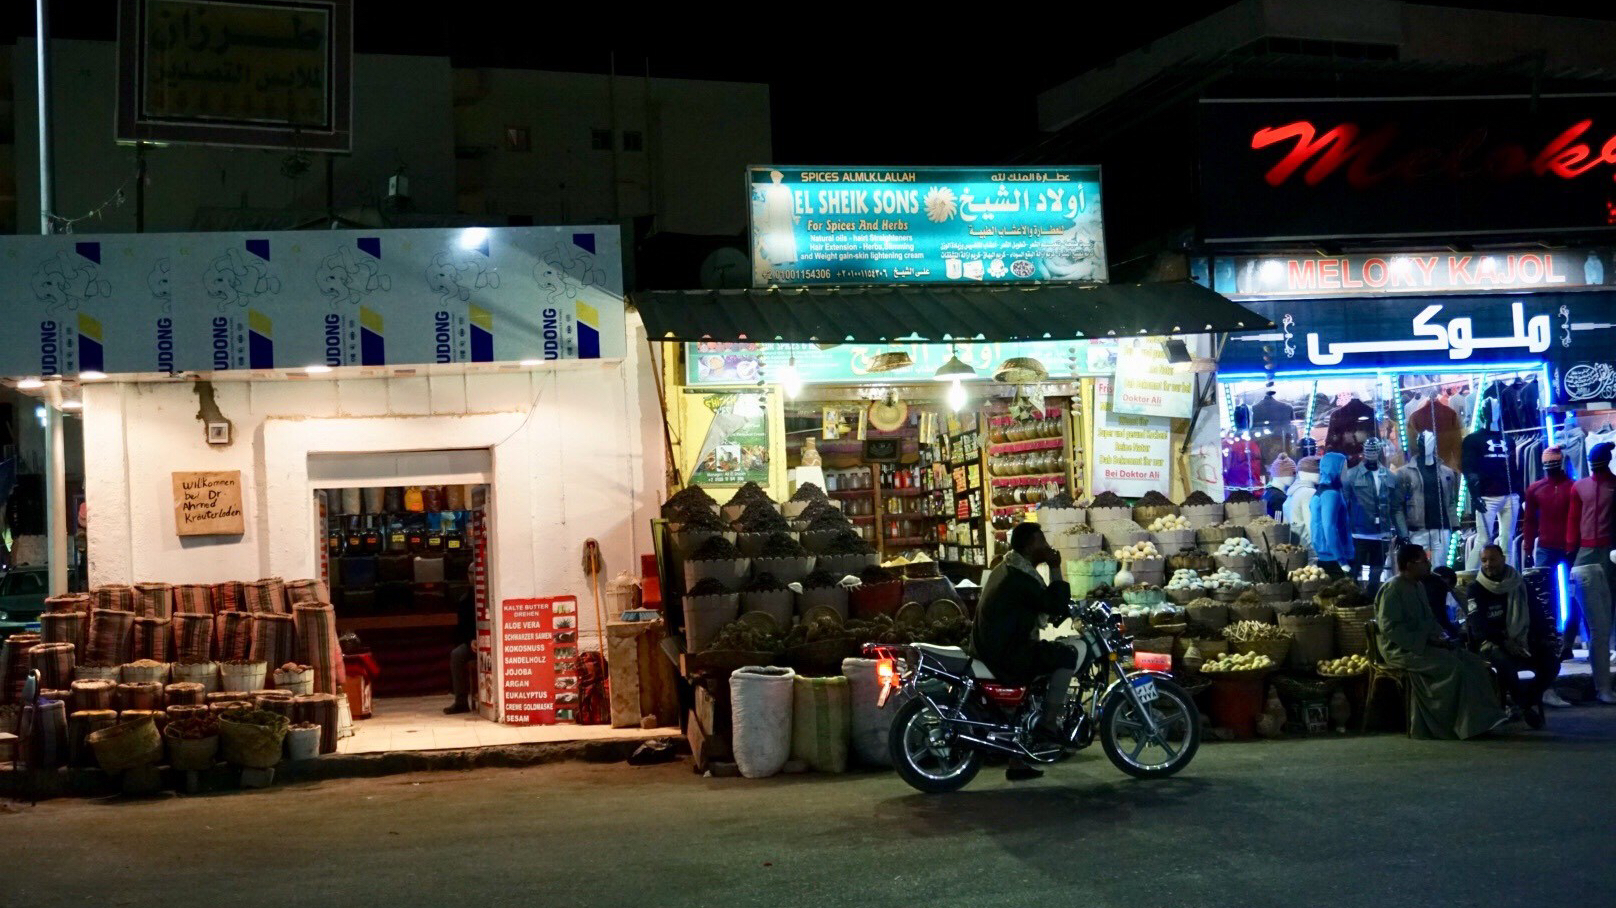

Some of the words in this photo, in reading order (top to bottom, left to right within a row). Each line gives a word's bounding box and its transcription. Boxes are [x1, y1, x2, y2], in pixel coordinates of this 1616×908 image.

[801, 172, 839, 182] SPICES
[794, 190, 814, 214] EL
[818, 190, 869, 214] SHEIK
[873, 190, 919, 214] SONS
[959, 183, 1029, 222] الشيخ
[1036, 183, 1085, 219] أولاد
[807, 220, 823, 231] For
[826, 219, 855, 233] Spices
[858, 219, 878, 231] And
[881, 219, 908, 231] Herbs
[810, 244, 824, 252] Hair
[825, 244, 858, 252] Extension
[814, 252, 838, 261] Weight
[1448, 254, 1566, 285] KAJOL
[325, 313, 340, 367] UDONG
[435, 310, 451, 364] UDONG
[542, 308, 558, 360] UDONG
[41, 320, 57, 376] UDONG
[157, 318, 173, 372] UDONG
[212, 316, 228, 370] UDONG
[1099, 383, 1114, 393] Fris
[1123, 394, 1150, 403] Doktor
[1151, 396, 1162, 404] Ali
[1105, 470, 1118, 478] Bei
[1119, 470, 1147, 479] Doktor
[1149, 471, 1160, 479] Ali
[183, 499, 218, 511] Ahmed
[504, 622, 522, 630] ALOE
[522, 621, 541, 629] VERA
[504, 644, 545, 653] KOKOSNUSS
[504, 656, 547, 664] SANDELHOLZ
[505, 668, 533, 676] JOJOBA
[505, 691, 548, 699] EUKALYPTUS
